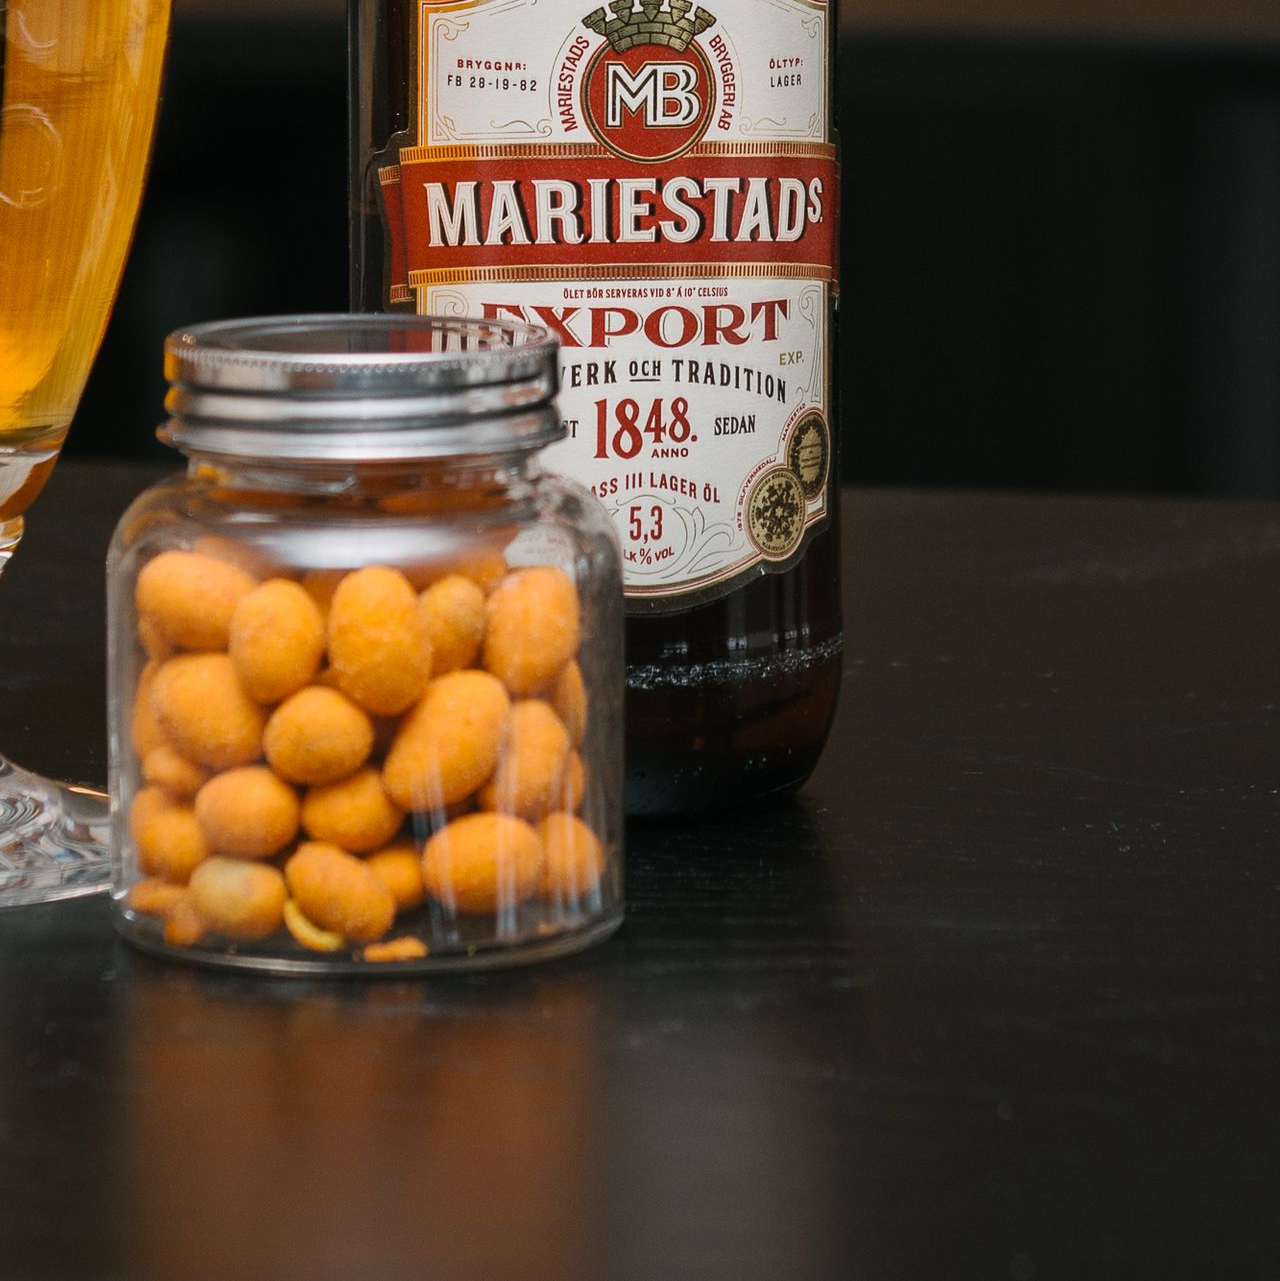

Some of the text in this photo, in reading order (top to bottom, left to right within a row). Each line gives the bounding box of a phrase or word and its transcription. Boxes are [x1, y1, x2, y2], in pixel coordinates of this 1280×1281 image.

[456, 59, 527, 71] BRYGGNR:
[769, 57, 804, 71] ÖLTYP:
[447, 74, 537, 92] FB 28-19-82
[557, 33, 736, 133] MARIESTADS BRYGGERI AB
[770, 74, 802, 88] LAGER
[604, 60, 703, 130] MB
[563, 287, 584, 299] ÖLET
[586, 287, 604, 299] BÖR
[605, 287, 648, 299] SERVERAS
[650, 287, 664, 298] VID
[697, 286, 729, 298] CELSIUS
[779, 350, 804, 367] EXP.
[629, 359, 661, 378] OCH
[671, 361, 787, 404] TRADITION
[713, 415, 756, 437] SEDAN
[651, 447, 690, 459] ANNO
[625, 472, 643, 491] III
[650, 472, 697, 503] LAGER
[703, 482, 721, 504] ÖL
[629, 505, 663, 544] 5,3
[639, 547, 652, 566] %
[654, 546, 675, 562] VOL
